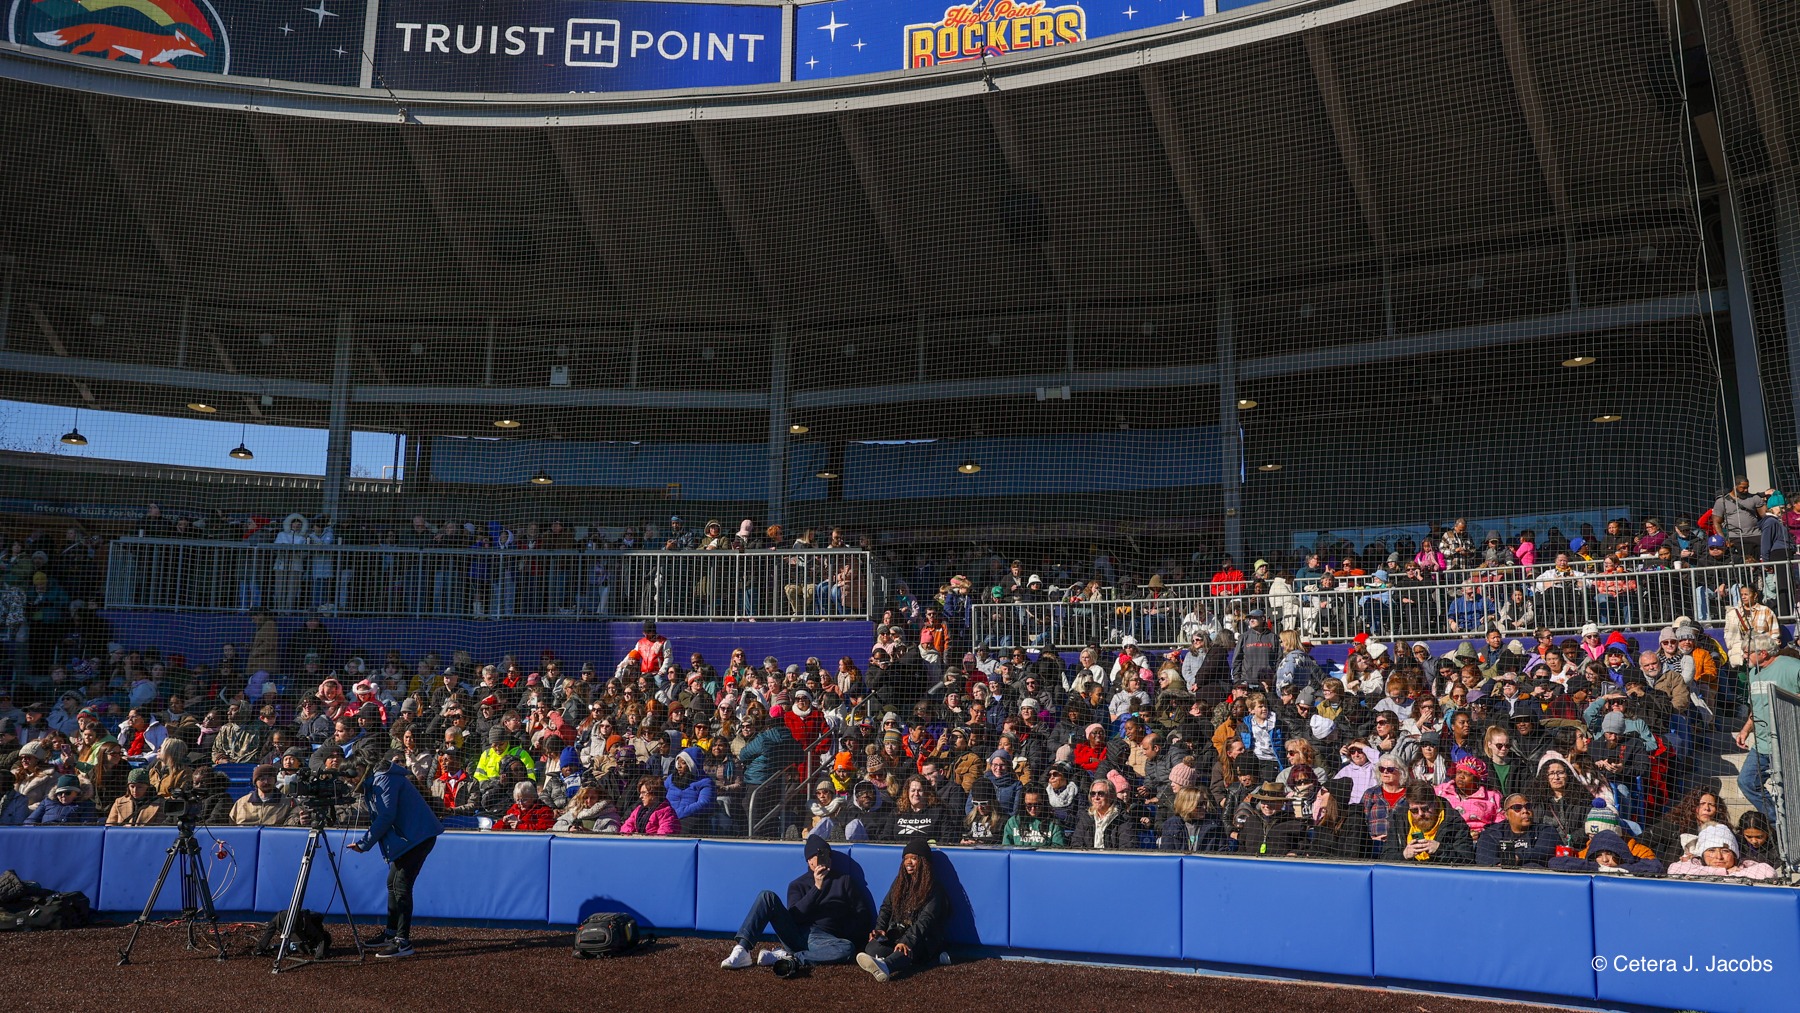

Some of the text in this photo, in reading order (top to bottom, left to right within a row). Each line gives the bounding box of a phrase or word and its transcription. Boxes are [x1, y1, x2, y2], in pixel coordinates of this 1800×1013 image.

[945, 0, 1042, 27] High Point
[396, 22, 765, 62] TRUIST POINT
[912, 12, 1080, 69] ROCKERS
[33, 504, 79, 514] Internet
[81, 506, 106, 516] built
[897, 817, 932, 825] Reebok
